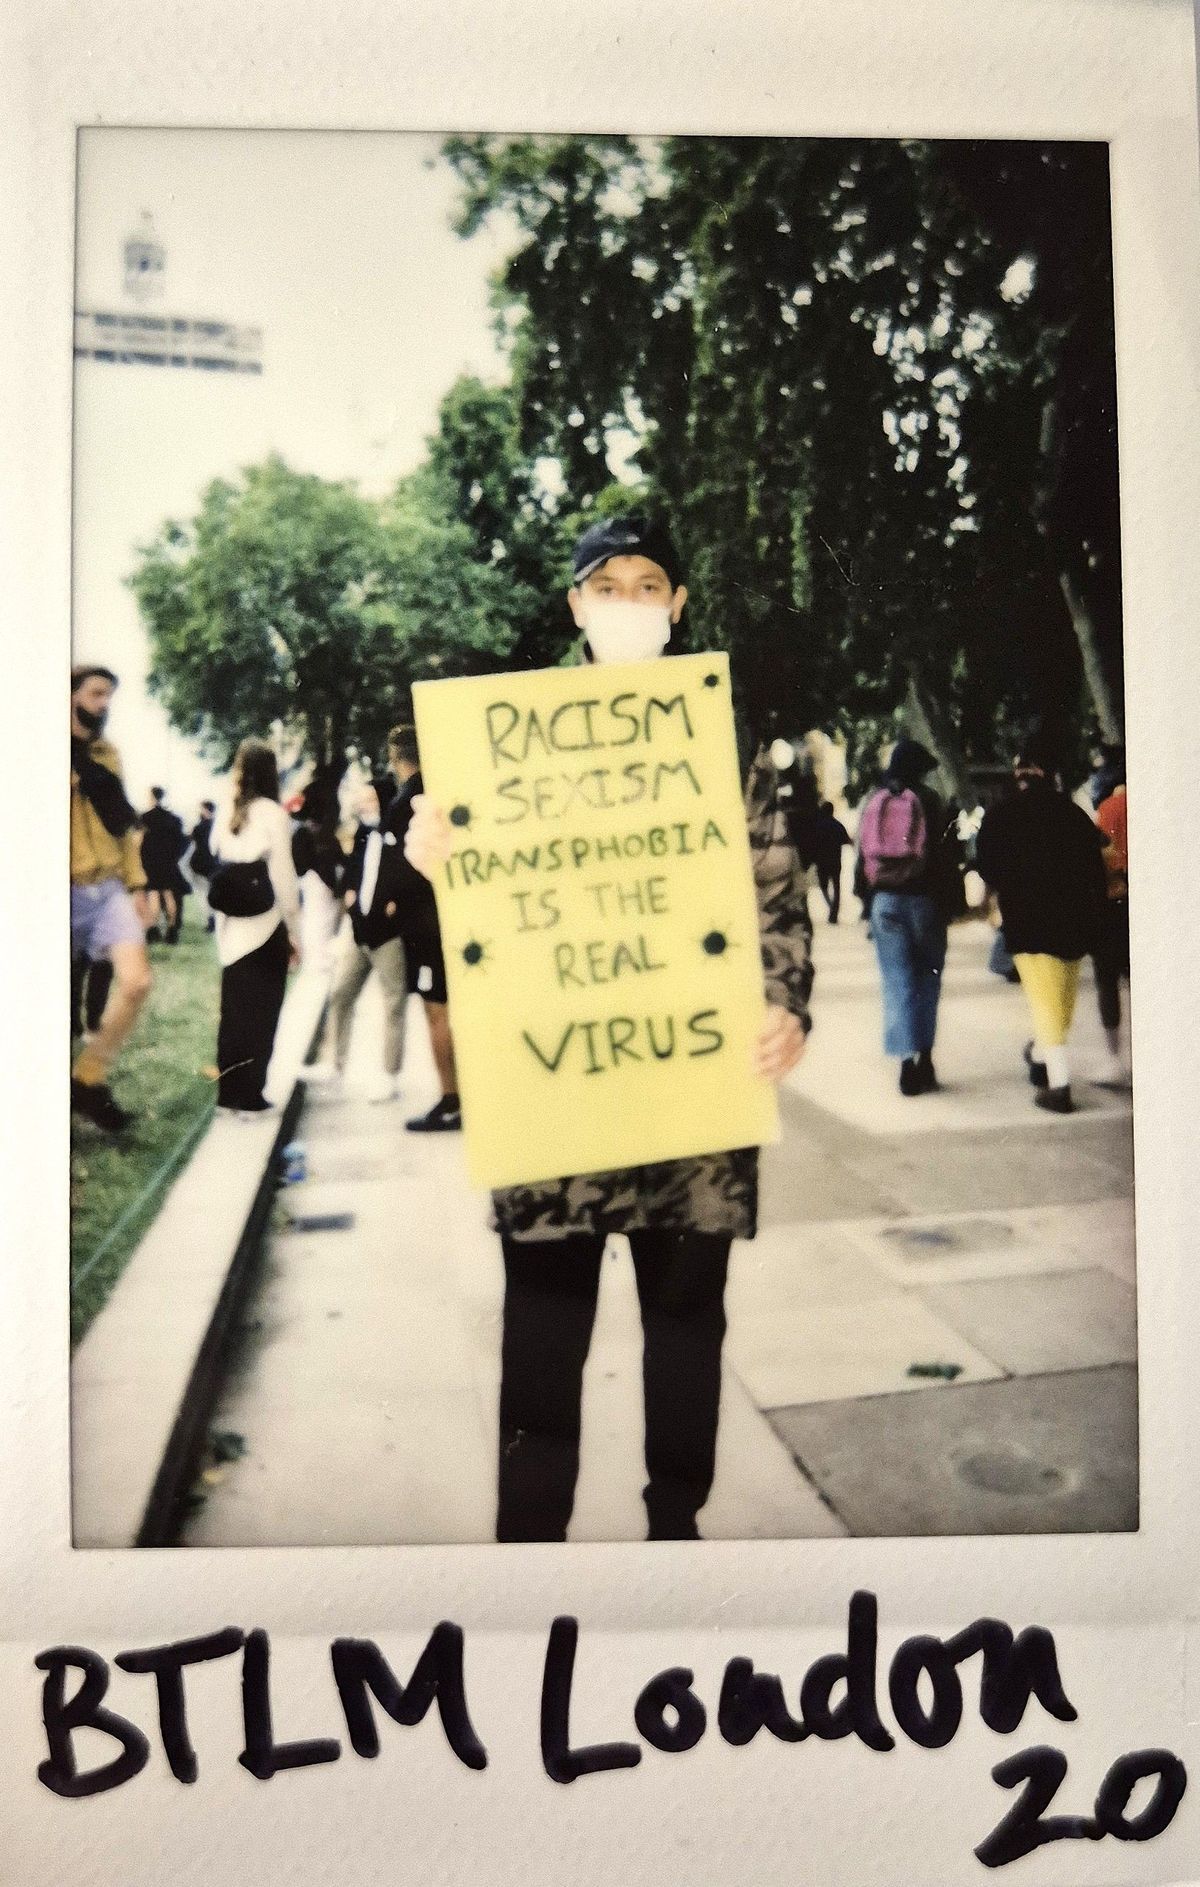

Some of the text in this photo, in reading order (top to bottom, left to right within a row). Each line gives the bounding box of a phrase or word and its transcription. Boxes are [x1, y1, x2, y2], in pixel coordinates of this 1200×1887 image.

[486, 692, 694, 769] RACISM
[494, 758, 702, 825] SEXISM
[444, 818, 728, 890] TRANSPHOBIA
[511, 875, 669, 933] IS THE
[554, 933, 667, 988] REAL
[521, 1008, 725, 1075] VIRUS
[35, 1589, 1077, 1798] BTLM London
[974, 1744, 1187, 1868] 20
